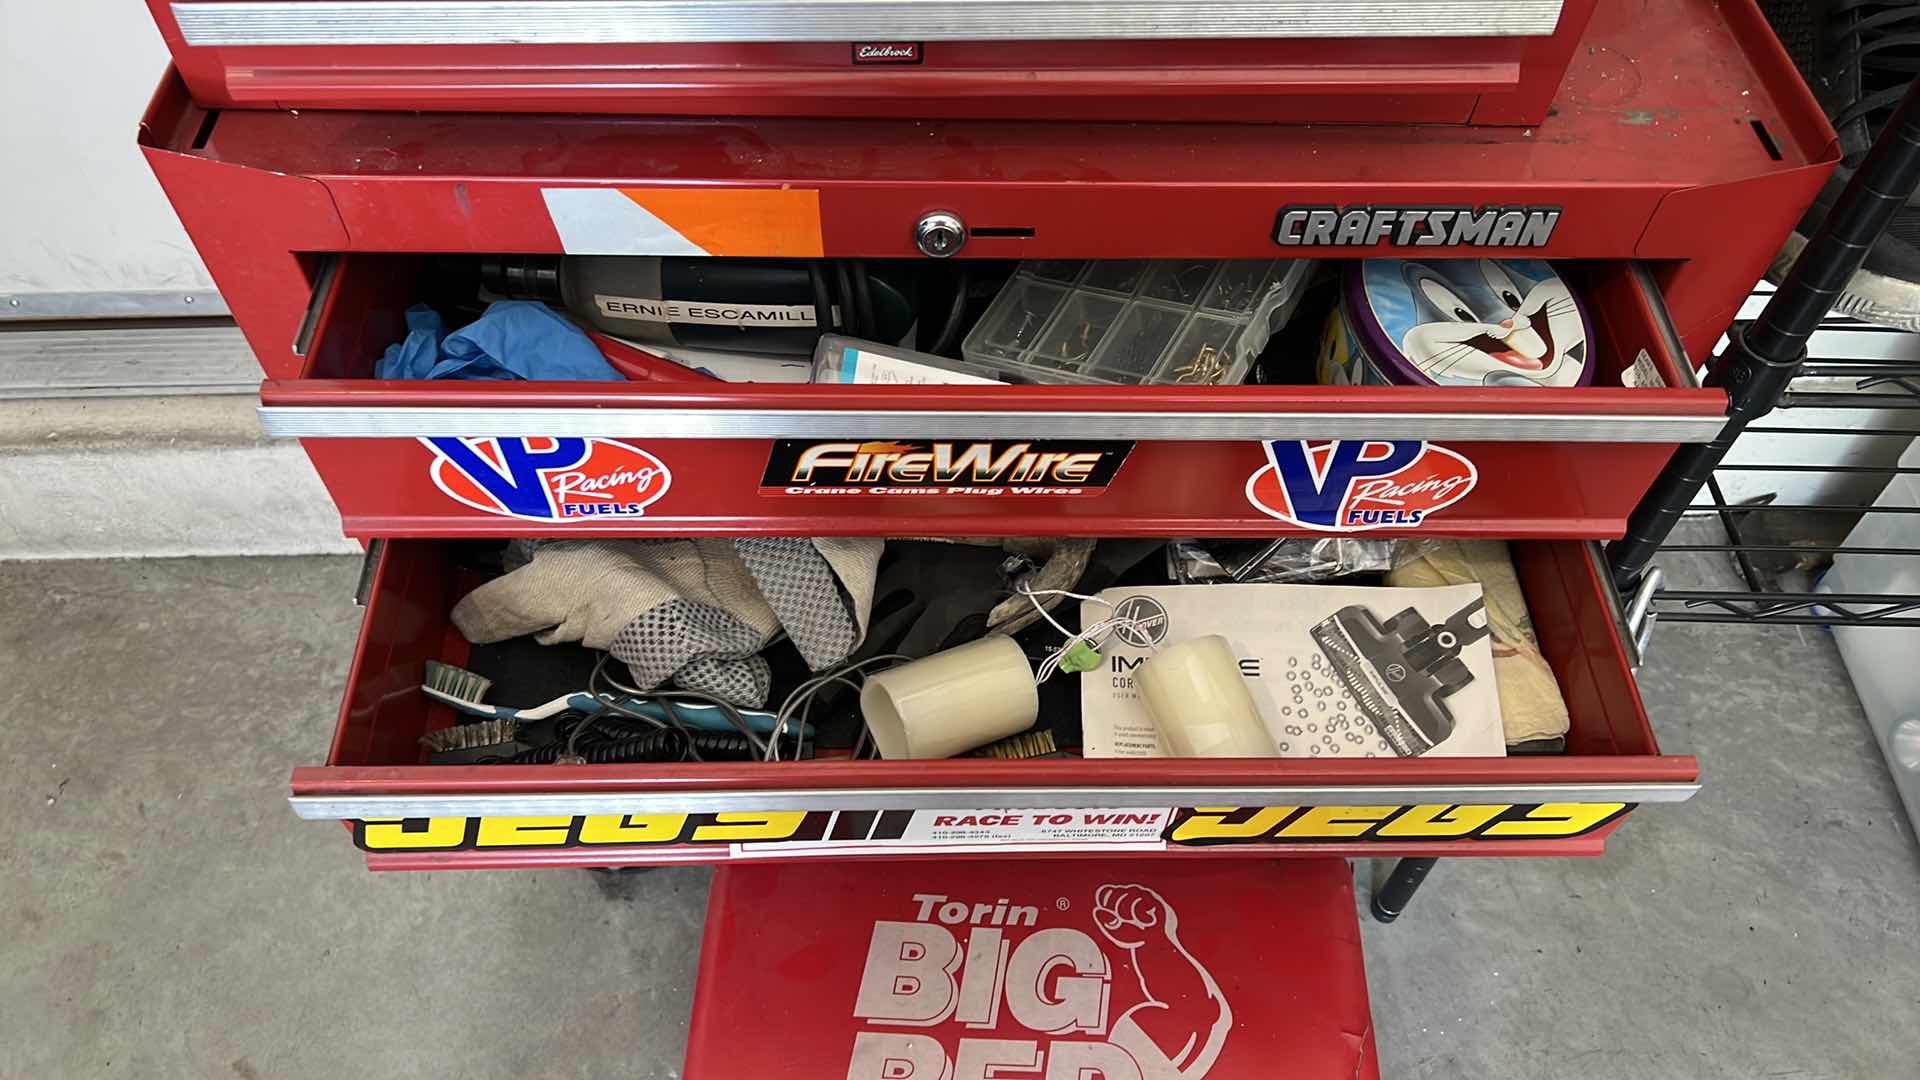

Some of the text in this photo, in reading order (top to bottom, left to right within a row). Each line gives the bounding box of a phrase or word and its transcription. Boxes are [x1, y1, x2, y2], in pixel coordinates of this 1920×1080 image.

[859, 46, 913, 57] Edelbrock
[1277, 210, 1560, 246] CRAFTSMAN
[605, 301, 815, 321] ERNIE ESCAMILL
[551, 466, 661, 502] Racing
[785, 487, 1083, 496] Crane Cams Plug Wires
[1350, 474, 1466, 508] Racing
[564, 504, 640, 515] FUELS
[1349, 510, 1422, 523] FUELS
[933, 813, 1161, 827] RACE TO WIN!
[912, 894, 1039, 926] Torin
[853, 920, 1112, 1035] BIG
